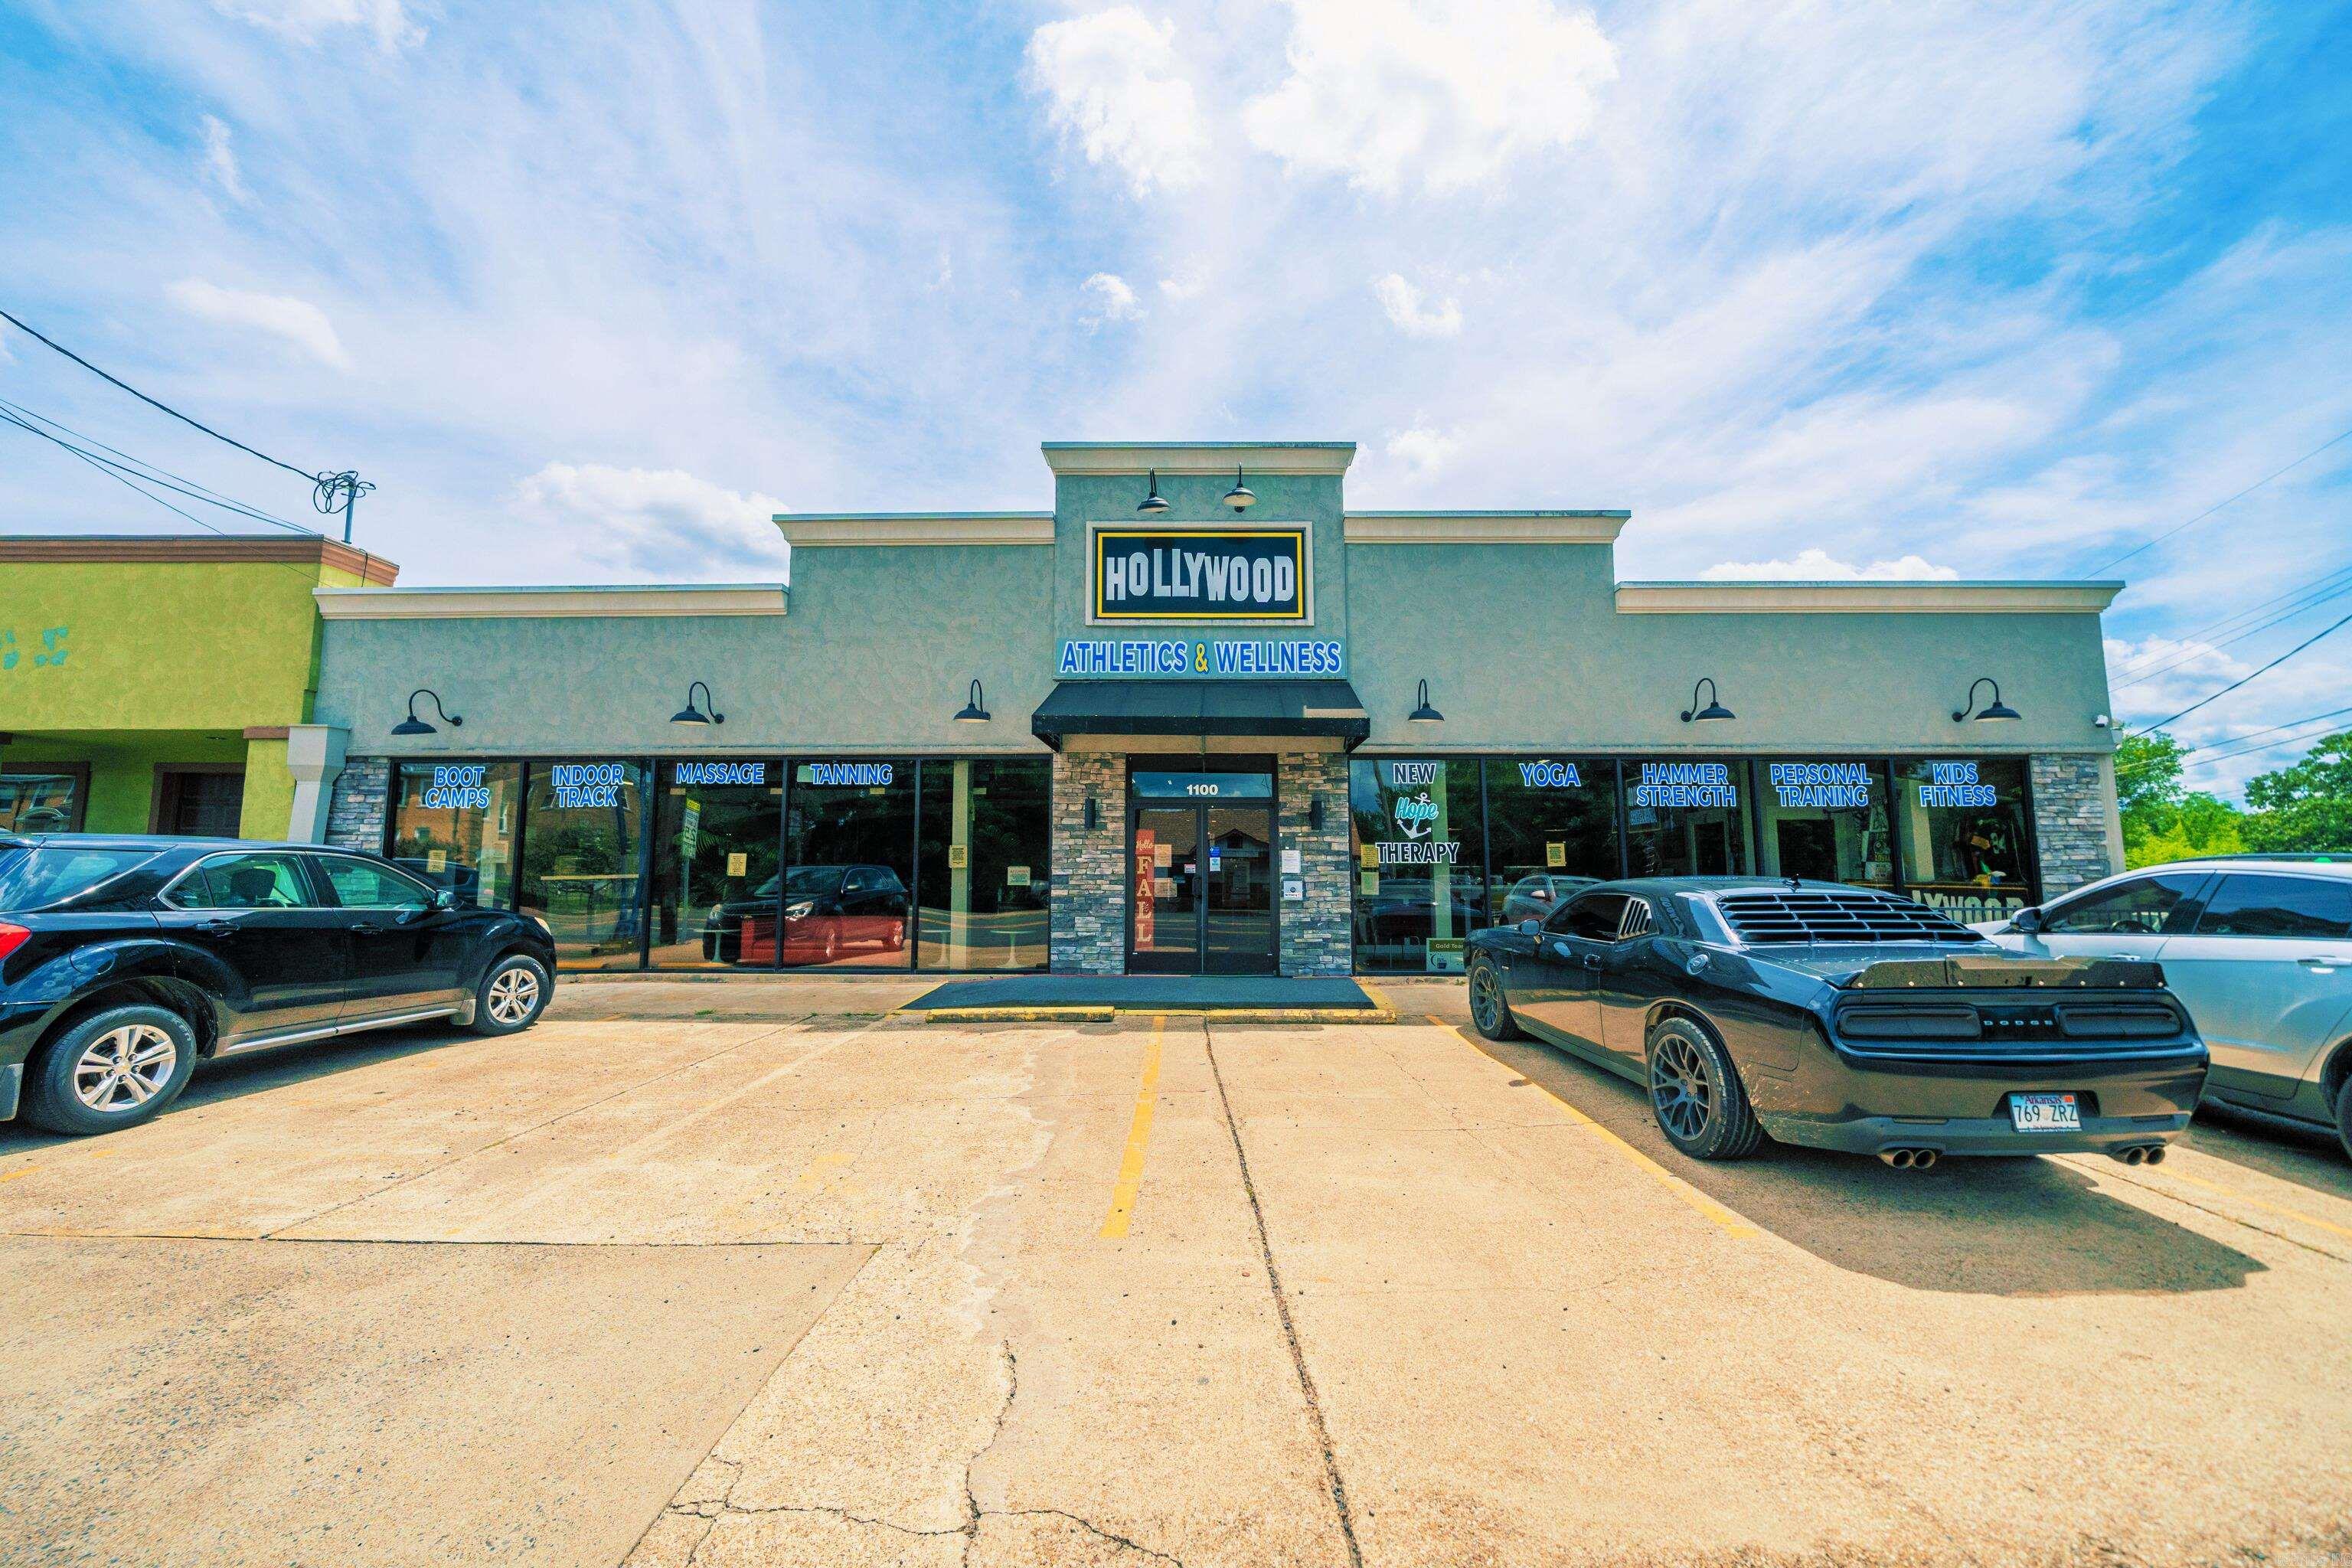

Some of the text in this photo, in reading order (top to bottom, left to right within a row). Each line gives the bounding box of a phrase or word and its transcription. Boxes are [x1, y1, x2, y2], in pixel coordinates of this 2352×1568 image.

[1106, 548, 1294, 603] HOLLYWOOD
[1060, 640, 1341, 675] ATHLETICS & WELLNESS
[433, 766, 485, 787] BOOT
[552, 764, 624, 786] INDOOR
[676, 763, 764, 784] MASSAGE
[810, 763, 893, 785] TANNING
[1393, 763, 1436, 785] NEW
[1518, 763, 1581, 787] YOGA
[1642, 763, 1728, 785] HAMMER
[1770, 763, 1872, 786] PERSONAL
[1932, 763, 1978, 785] KIDS
[425, 787, 490, 808] CAMPS
[556, 786, 619, 808] TRACK
[1186, 784, 1219, 795] 1100
[1636, 785, 1736, 808] STRENGTH
[1775, 785, 1868, 807] TRAINING
[1919, 785, 1997, 808] FITNESS
[1394, 796, 1439, 826] Hope
[1135, 838, 1154, 851] Hello
[1376, 842, 1460, 864] THERAPY
[1136, 856, 1152, 942] FALL
[2025, 1095, 2062, 1105] Arkansas
[2014, 1105, 2078, 1122] 769 ZRZ
